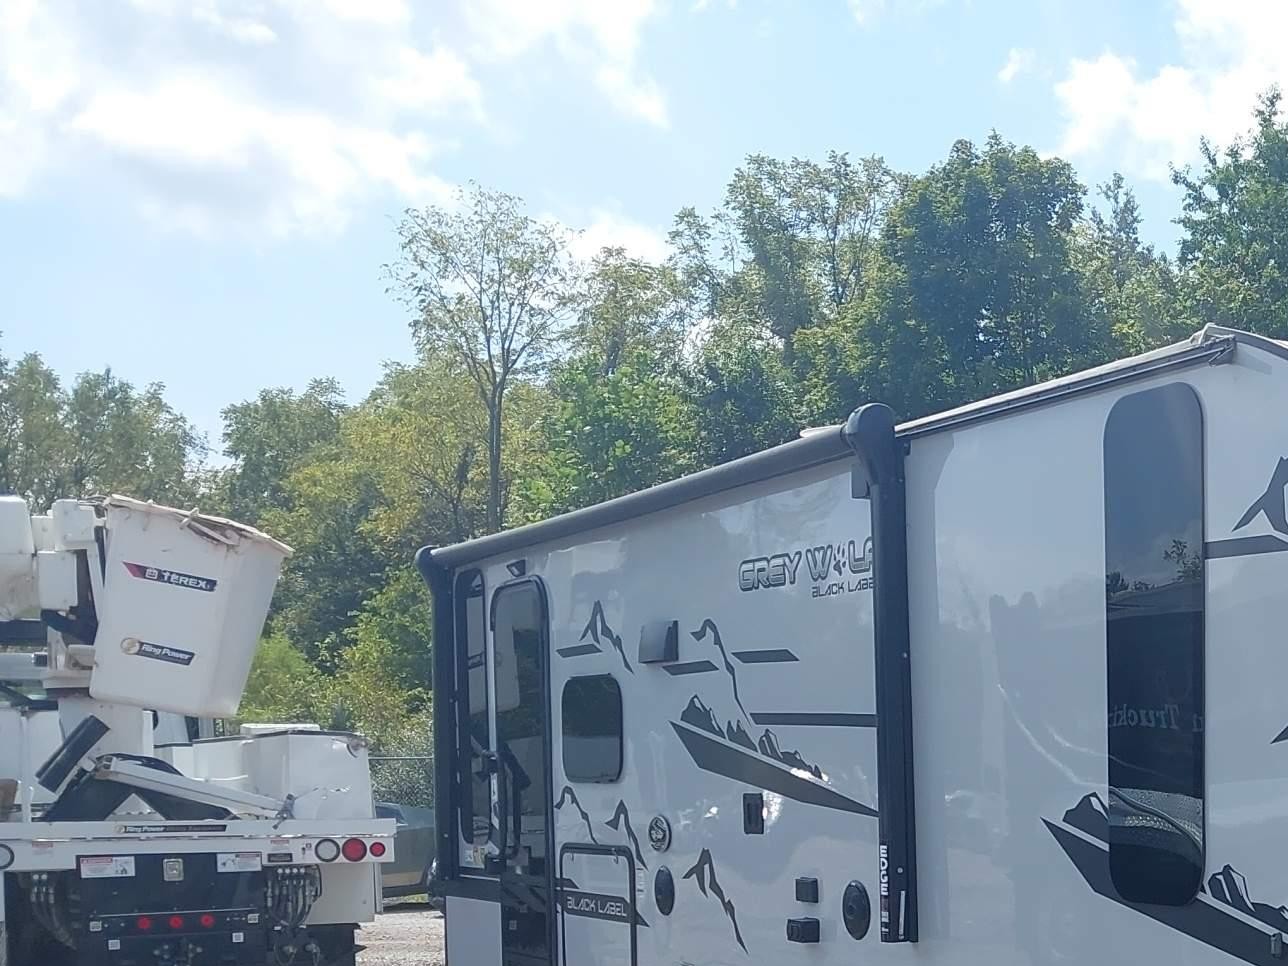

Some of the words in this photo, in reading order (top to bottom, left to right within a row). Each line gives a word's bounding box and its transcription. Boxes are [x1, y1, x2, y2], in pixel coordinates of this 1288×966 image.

[161, 571, 207, 589] TEREX
[738, 550, 803, 592] GREY
[811, 582, 845, 598] BLACK
[141, 643, 161, 656] Ring
[162, 648, 192, 660] Power
[879, 844, 889, 896] EDGE
[566, 896, 596, 912] BLACK
[597, 901, 628, 917] LABEL
